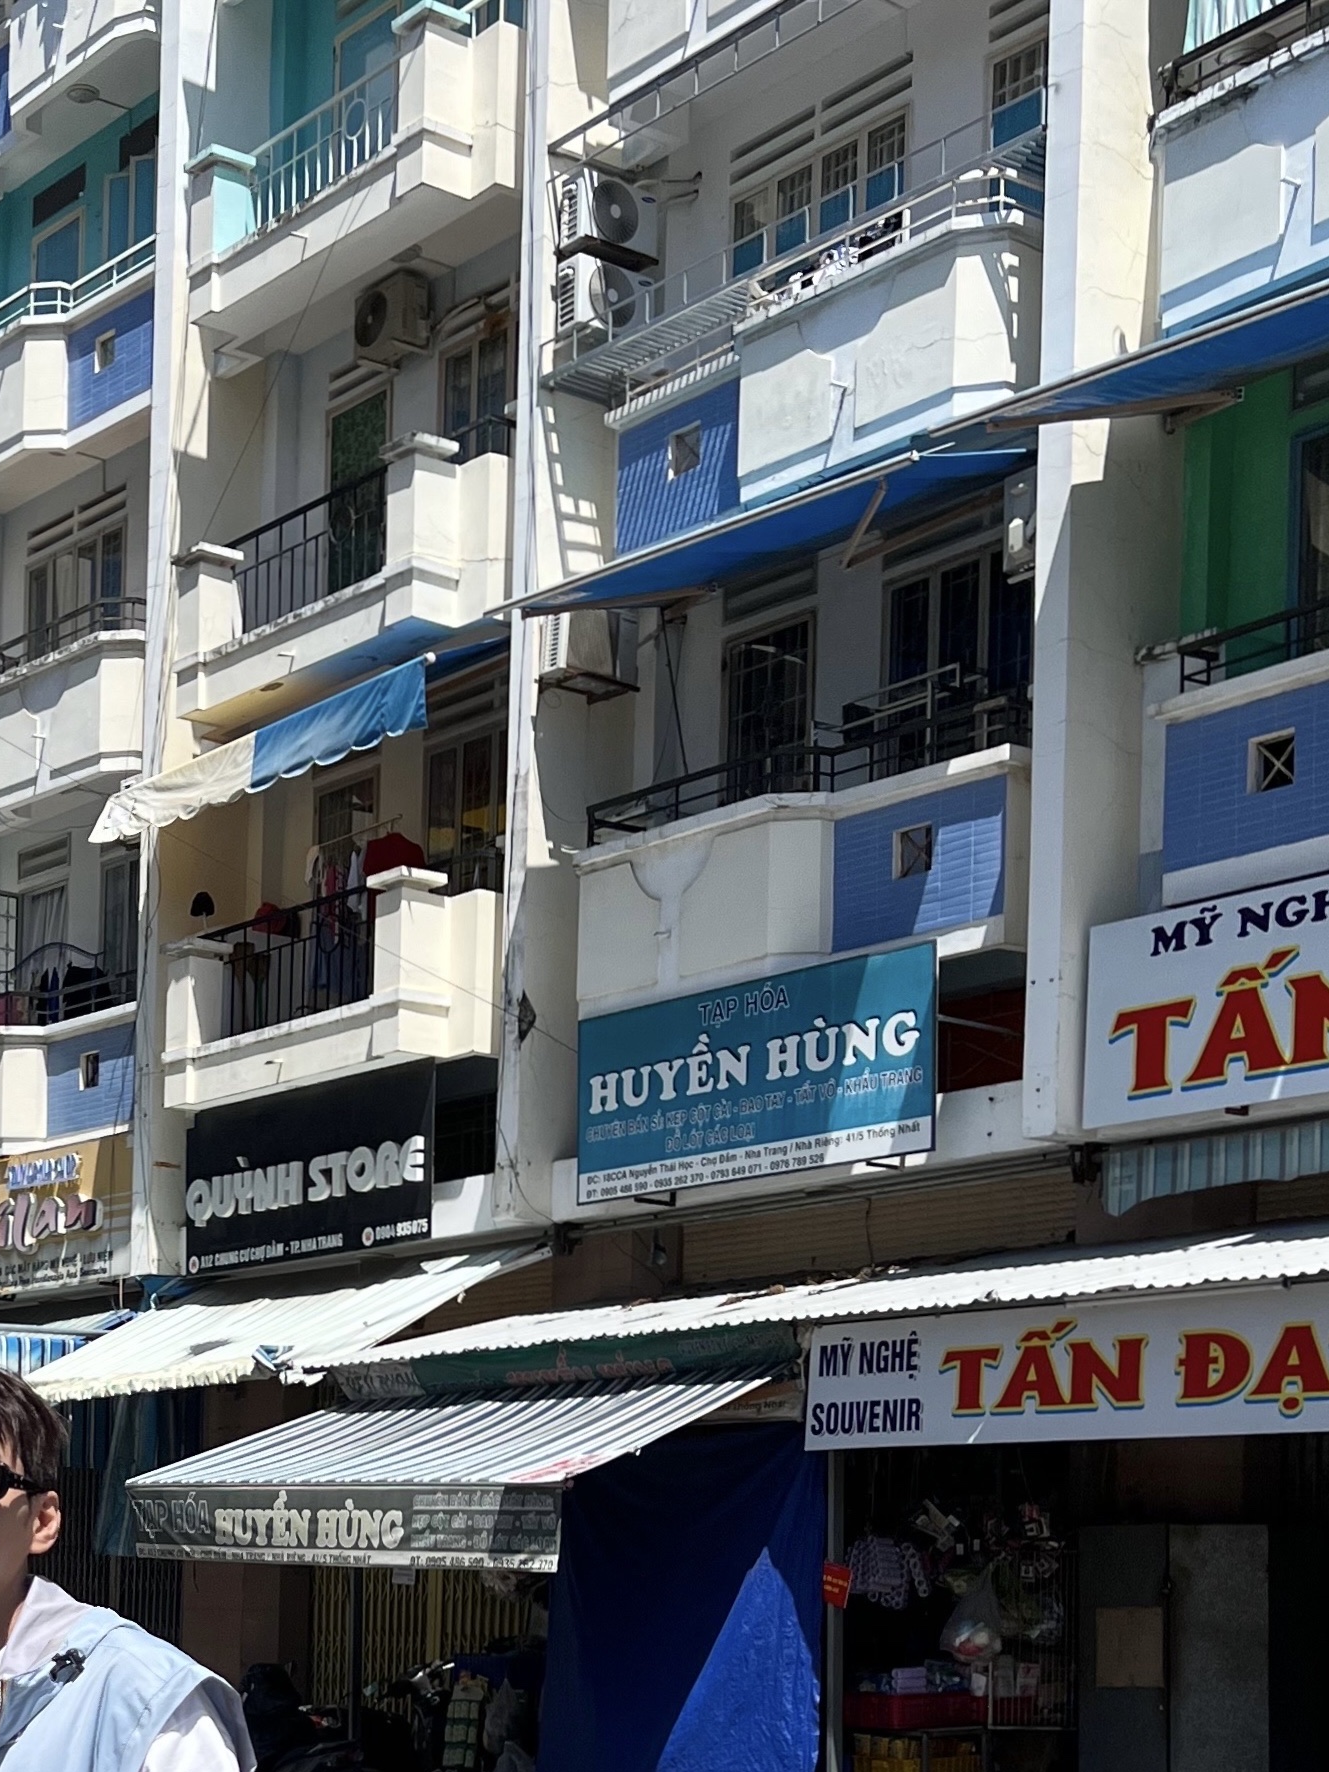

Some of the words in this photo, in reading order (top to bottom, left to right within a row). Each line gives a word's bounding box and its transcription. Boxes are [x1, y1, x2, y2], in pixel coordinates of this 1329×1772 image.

[1150, 904, 1223, 957] MỸ
[698, 996, 738, 1028] TẠP
[744, 981, 790, 1018] HÓA
[588, 1032, 752, 1115] HUYỀN
[765, 1009, 921, 1082] HÙNG
[586, 1119, 626, 1143] CHUYÊN
[627, 1113, 649, 1136] BÁN
[689, 1102, 711, 1127] CỘT
[712, 1098, 732, 1121] CÀI
[739, 1095, 764, 1115] BAO
[764, 1090, 786, 1111] TAY
[793, 1079, 817, 1106] TẤT
[844, 1066, 878, 1096] KHẨU
[879, 1065, 923, 1090] TRANG
[678, 1159, 694, 1171] Học
[700, 1156, 717, 1168] Chợ
[745, 1148, 761, 1160] Nha
[764, 1145, 787, 1157] Trang
[795, 1141, 812, 1151] Nhà
[846, 1133, 864, 1143] 41/5
[867, 1127, 895, 1139] Thống
[898, 1120, 920, 1135] Nhất
[682, 1128, 704, 1150] LÓT
[705, 1124, 729, 1145] CÁC
[729, 1121, 756, 1143] LOẠI
[186, 1156, 304, 1227] QUỲNH
[308, 1135, 425, 1202] STORE
[690, 1173, 704, 1183] 370
[731, 1166, 746, 1176] 649
[748, 1164, 762, 1174] 071
[770, 1159, 790, 1170] 0976
[792, 1156, 807, 1167] 789
[809, 1153, 824, 1164] 526
[318, 1233, 344, 1251] TRANG
[818, 1336, 854, 1378] MỸ
[859, 1331, 919, 1381] NGHỆ
[939, 1317, 1149, 1417] TẤN
[810, 1397, 922, 1436] SOUVENIR
[172, 1492, 211, 1534] HÓA
[214, 1490, 312, 1547] HUYỀN
[316, 1498, 405, 1549] HÙNG
